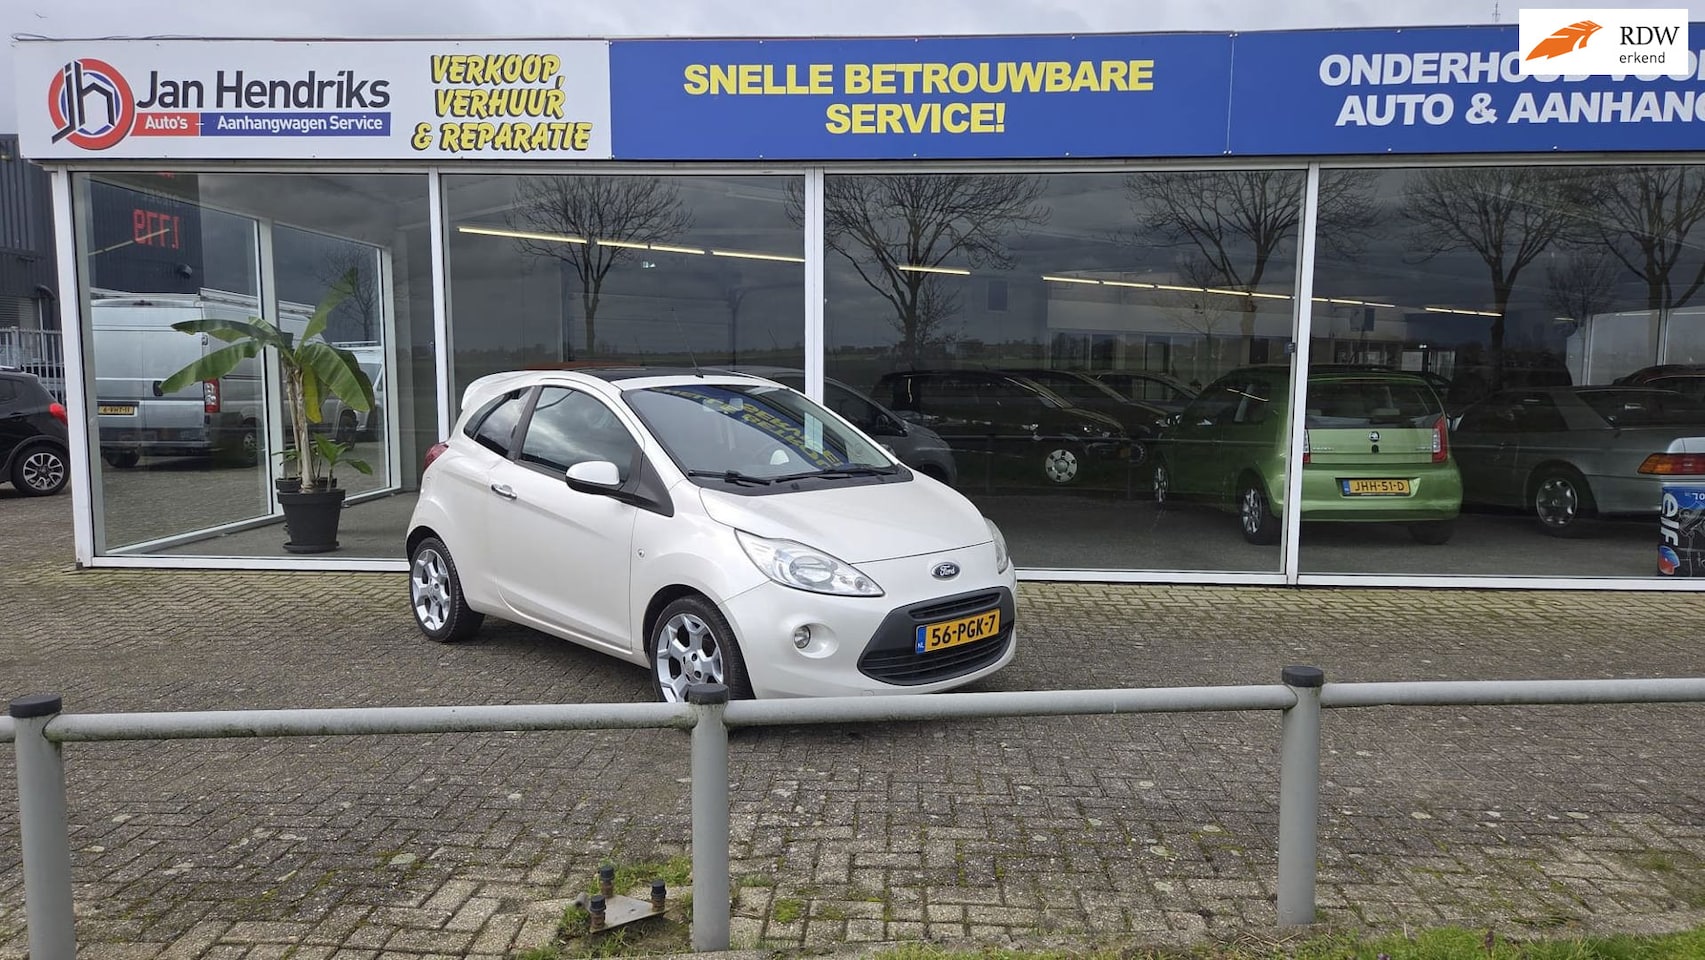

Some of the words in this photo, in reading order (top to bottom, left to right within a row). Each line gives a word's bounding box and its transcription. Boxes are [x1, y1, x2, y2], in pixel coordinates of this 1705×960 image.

[431, 54, 565, 89] VERKOOP,
[683, 63, 834, 95] SNELLE
[845, 60, 1154, 94] BETROUWBARE
[1319, 51, 1589, 86] ONDERHO
[136, 70, 204, 109] Jan
[215, 70, 391, 109] Hendriks
[435, 88, 566, 119] VERHUUR
[145, 115, 188, 130] Auto's
[217, 115, 328, 133] Aanhangwagen
[329, 114, 383, 130] Service
[825, 102, 1006, 134] SERVICE!
[1335, 93, 1454, 126] AUTO
[1465, 92, 1498, 125] &
[411, 122, 433, 150] &
[440, 122, 593, 153] REPARATIE
[1354, 480, 1405, 492] JHH-51-D
[1661, 492, 1680, 547] elf
[939, 564, 956, 576] Ford
[931, 614, 996, 647] 56-PGK-7
